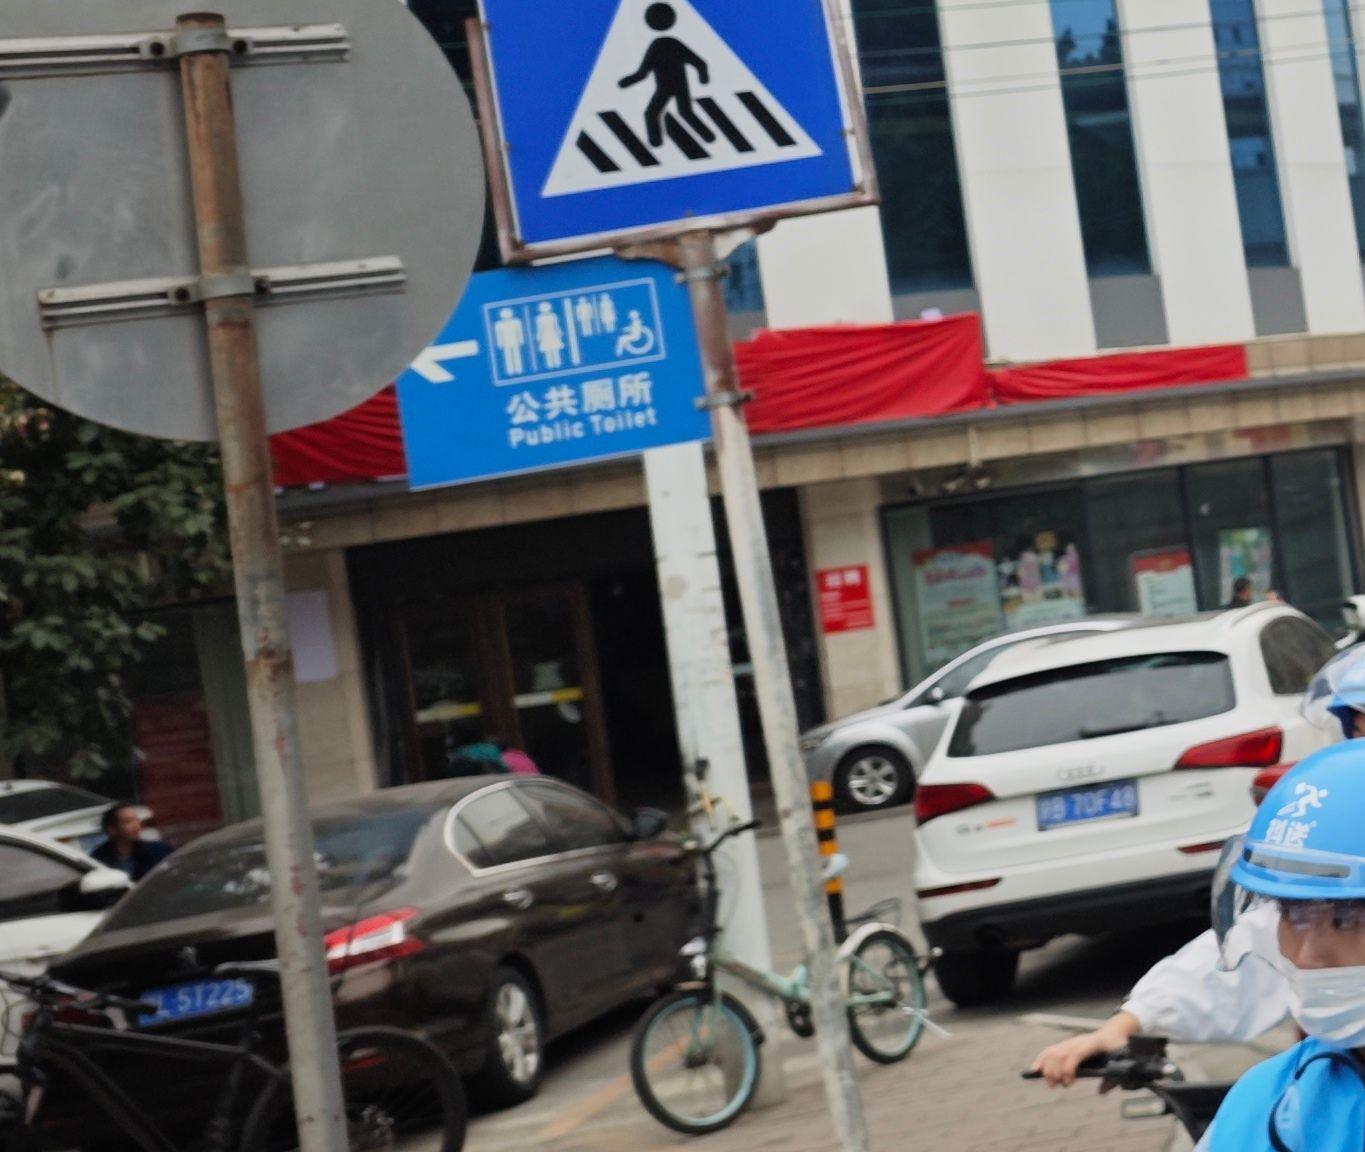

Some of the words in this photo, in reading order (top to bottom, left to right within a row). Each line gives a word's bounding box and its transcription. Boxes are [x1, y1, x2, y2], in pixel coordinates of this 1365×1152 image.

[506, 370, 653, 425] 公共厕所
[509, 419, 585, 448] Public
[590, 407, 657, 436] Toilet
